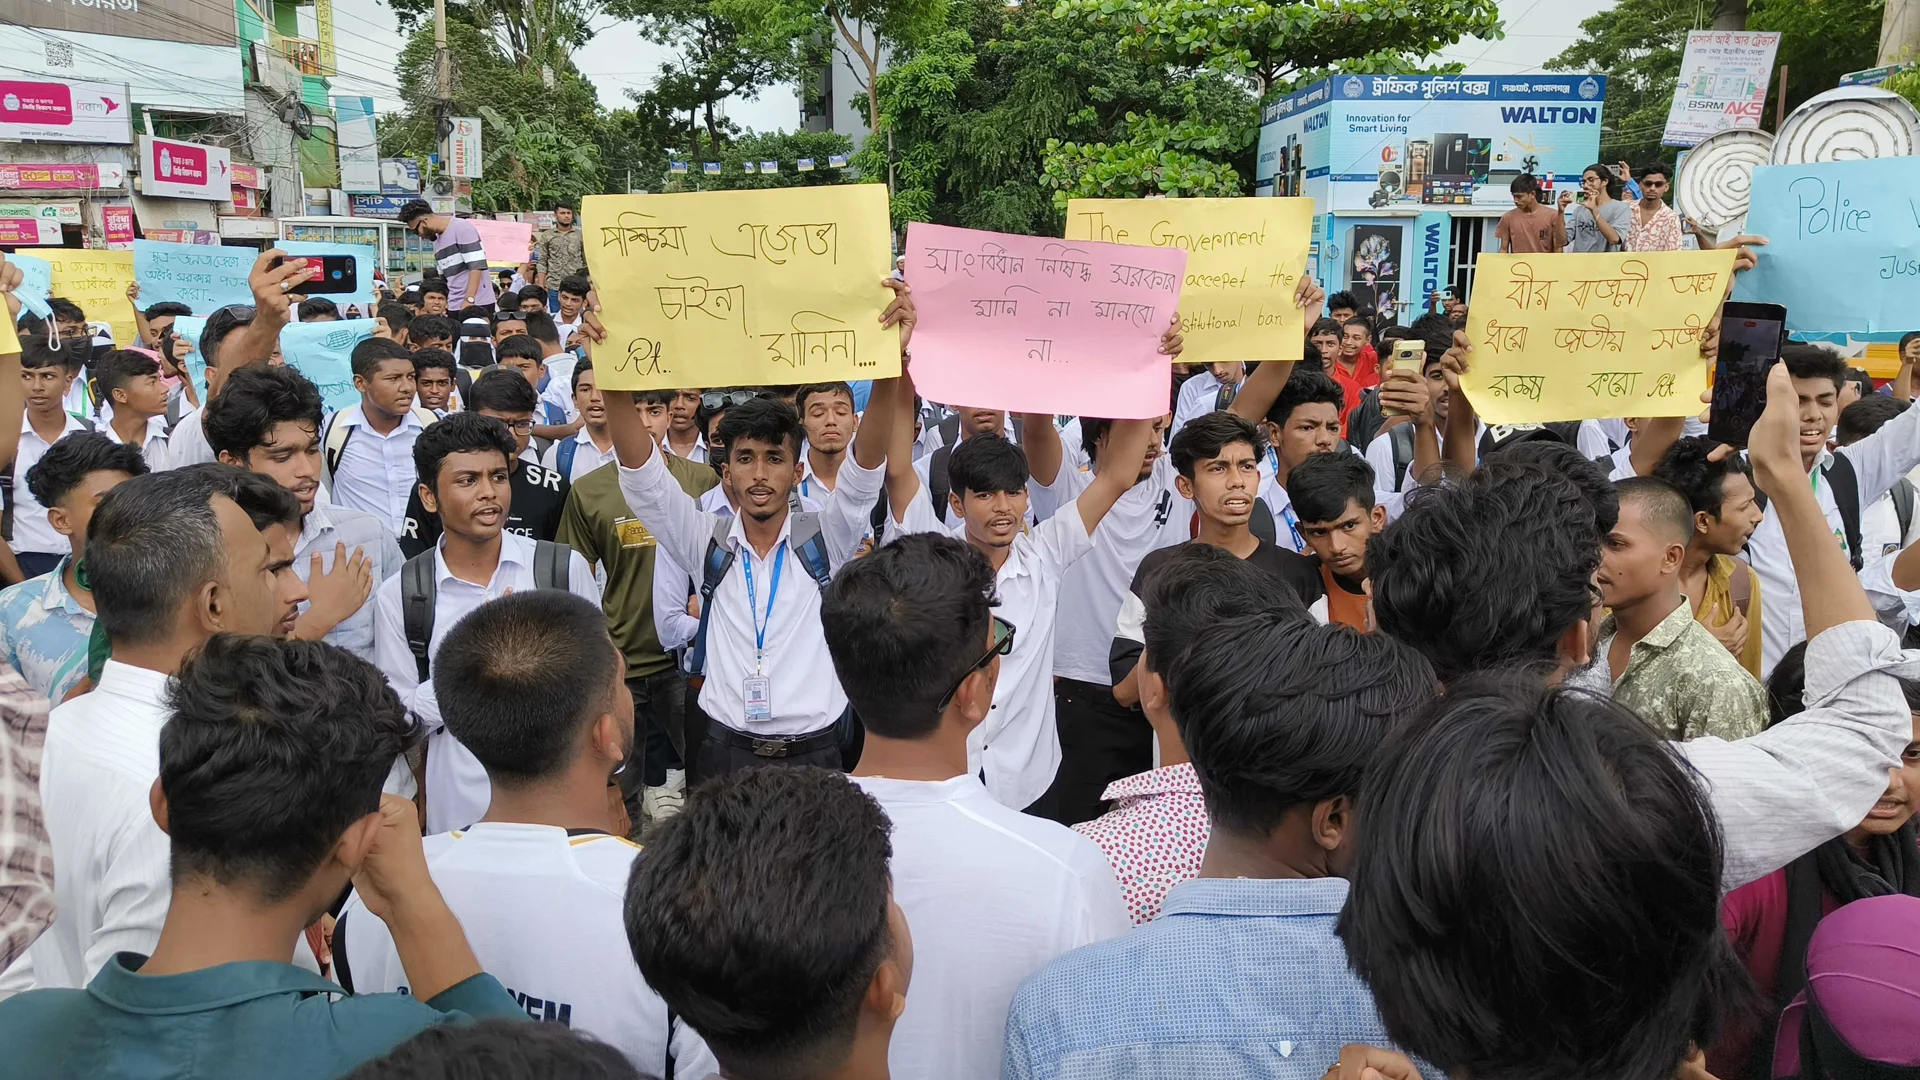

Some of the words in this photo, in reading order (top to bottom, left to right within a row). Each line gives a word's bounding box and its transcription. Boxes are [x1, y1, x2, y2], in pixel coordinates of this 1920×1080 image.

[1372, 76, 1419, 96] ট্রাফিক
[1421, 76, 1461, 98] পুলিশ
[1462, 80, 1490, 96] বক্স
[1346, 114, 1394, 122] Innovation
[1397, 113, 1411, 122] for
[1500, 106, 1597, 124] WALTON
[1688, 101, 1724, 110] BSRM
[1724, 101, 1762, 115] AKS
[1304, 110, 1329, 134] WALTON
[1349, 124, 1377, 133] Smart
[1380, 123, 1407, 134] Living
[456, 139, 464, 164] BAZAAR
[456, 165, 464, 175] BIG
[354, 194, 384, 205] সিটি
[1788, 176, 1871, 241] Police
[107, 215, 129, 224] সুবিধা
[108, 222, 130, 231] ডাবল
[1077, 211, 1129, 243] The
[1269, 262, 1294, 286] the
[1422, 222, 1441, 309] WALTON
[1110, 263, 1176, 293] সরকার
[1506, 261, 1559, 311] বীর
[1047, 300, 1071, 318] না
[1090, 299, 1155, 329] মানবো
[1181, 304, 1244, 333] stitutional
[1484, 318, 1529, 354] ধরো
[1586, 372, 1643, 397] করো
[525, 464, 562, 492] SR
[402, 516, 419, 539] R
